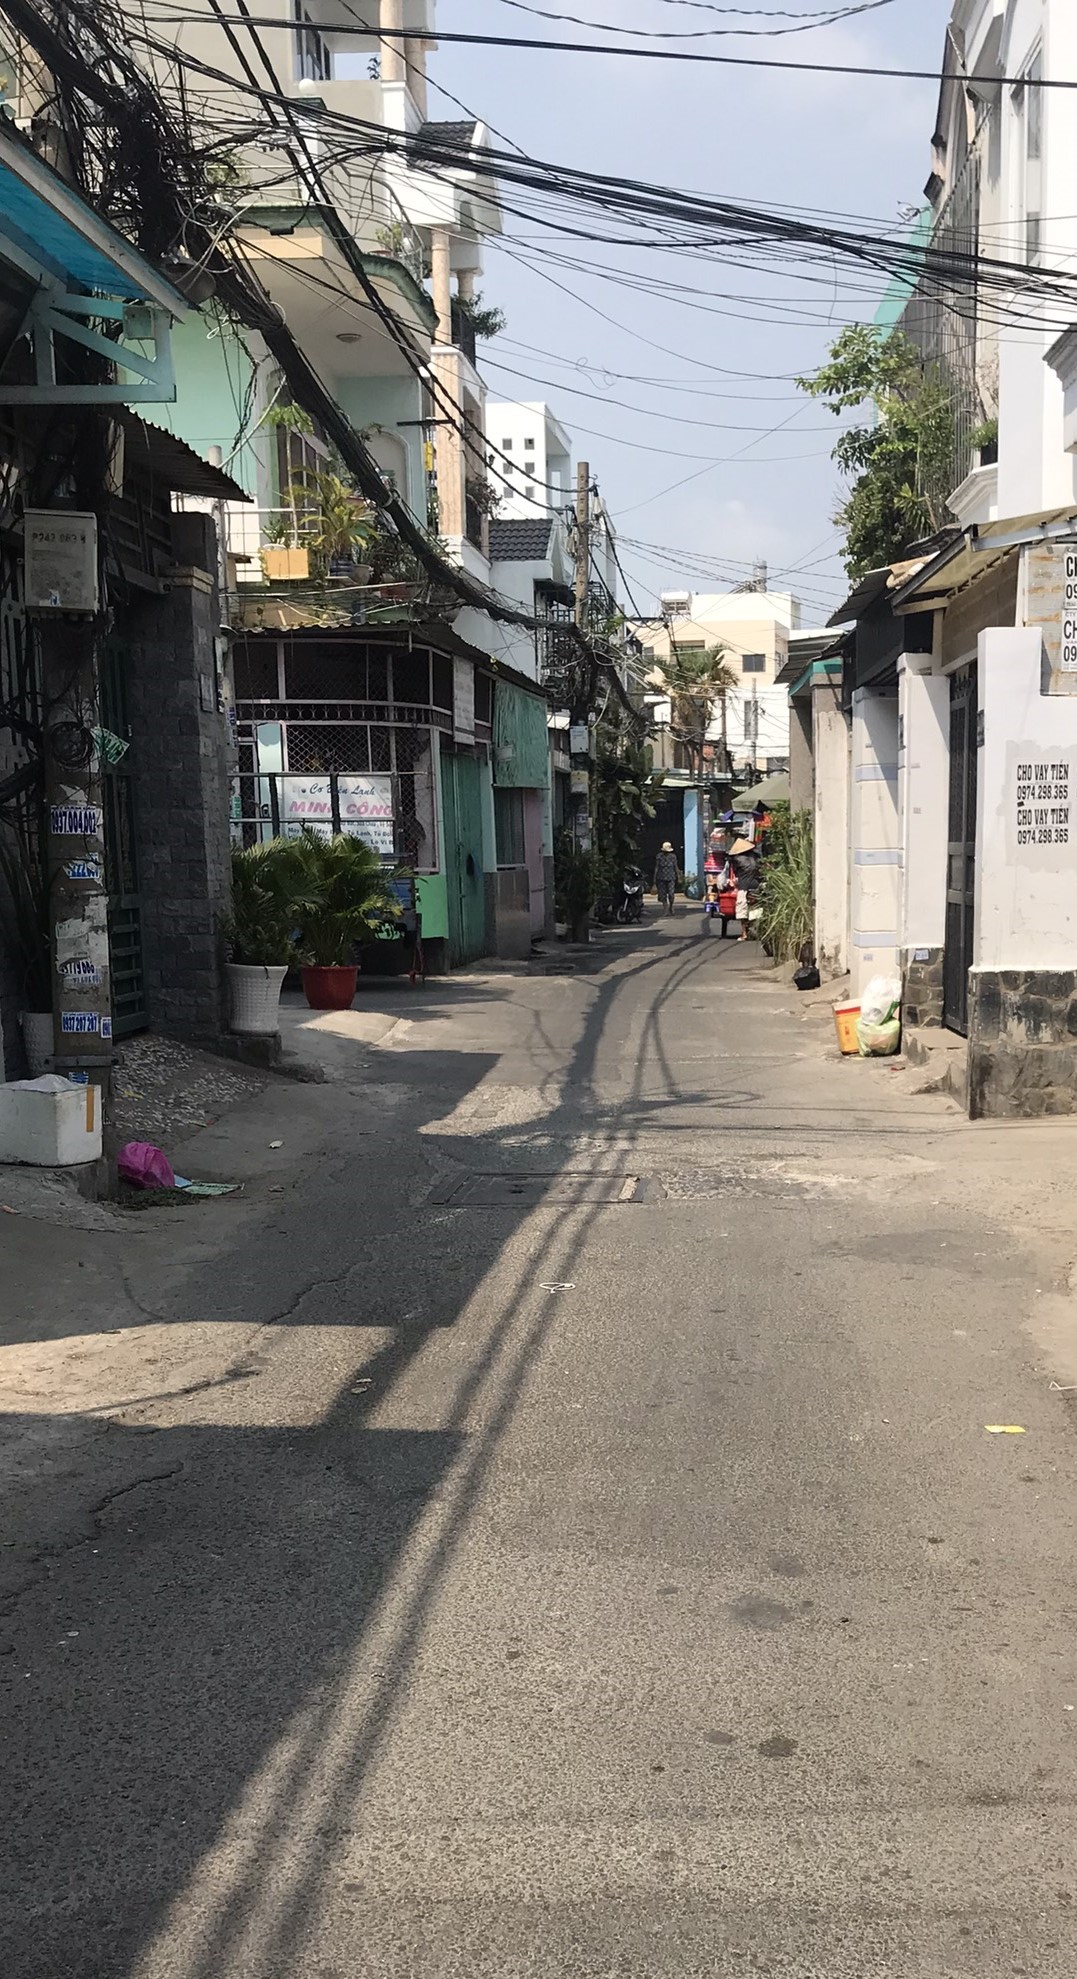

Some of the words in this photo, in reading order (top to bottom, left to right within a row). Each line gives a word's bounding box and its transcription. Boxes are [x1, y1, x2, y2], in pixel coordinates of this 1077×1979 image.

[1017, 764, 1032, 781] CHO
[1034, 764, 1049, 781] VAY
[1017, 784, 1068, 800] 0974.298.365
[290, 801, 331, 813] MIN
[1017, 809, 1032, 826] CHO
[1034, 809, 1049, 825] VAY
[1017, 828, 1069, 845] 0974.298.365
